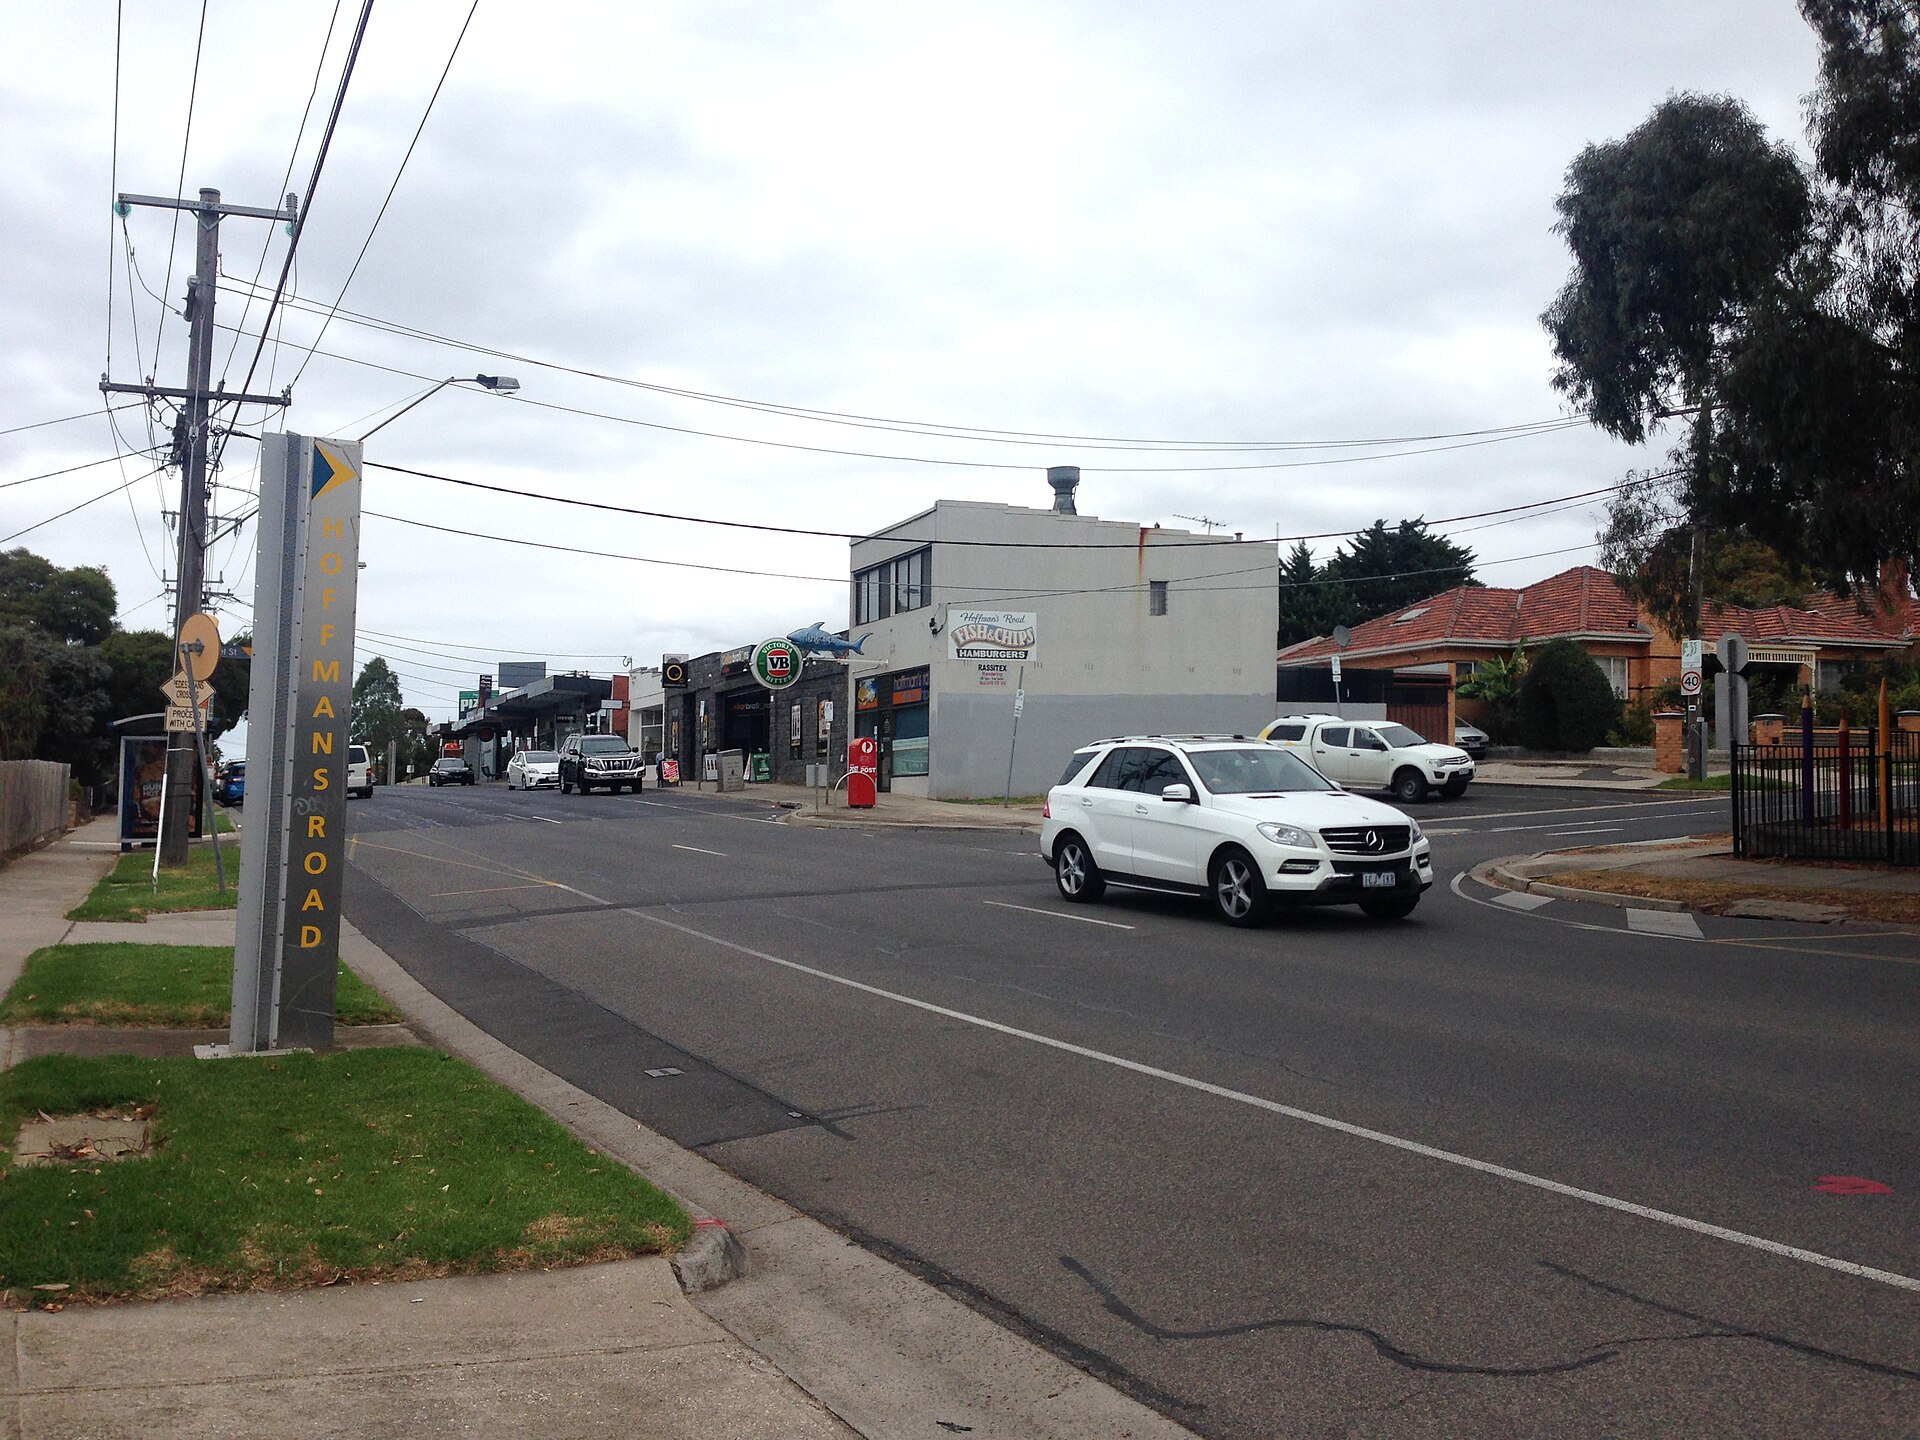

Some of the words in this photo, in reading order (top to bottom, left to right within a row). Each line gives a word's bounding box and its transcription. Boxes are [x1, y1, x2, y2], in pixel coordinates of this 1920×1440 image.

[960, 612, 1000, 624] Hoffman's
[1003, 613, 1026, 624] Road
[228, 648, 237, 656] St
[312, 515, 343, 790] HOFFMANS
[761, 642, 794, 654] VICTORIA
[959, 649, 1026, 659] HAMBURGERS
[768, 656, 790, 669] VB
[977, 664, 1007, 672] RASSITEX
[765, 674, 793, 684] BITTER
[1684, 676, 1699, 687] 40
[173, 680, 205, 690] PEDESANS
[175, 690, 200, 699] CROSG
[172, 709, 202, 719] PROCED
[169, 720, 185, 728] WITH
[186, 720, 204, 729] CAE
[300, 815, 328, 948] ROAD
